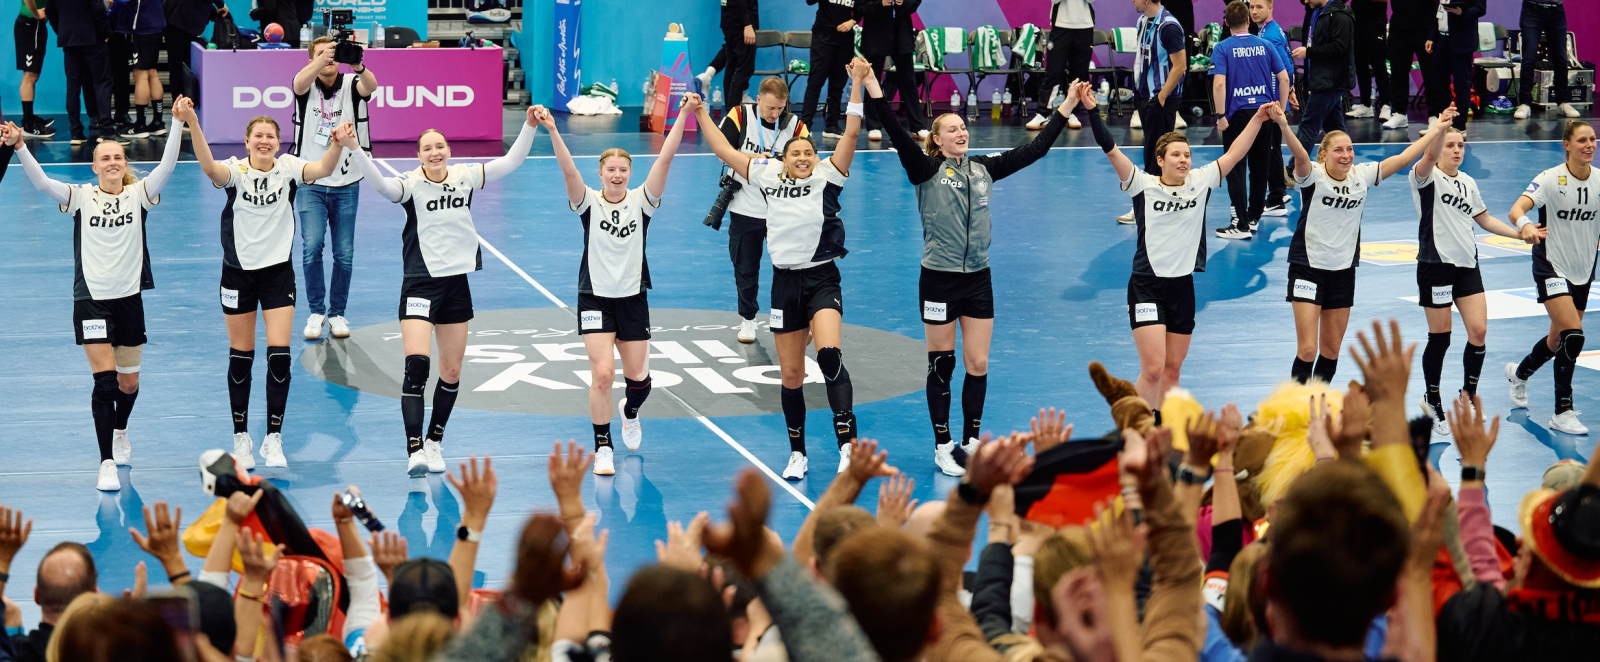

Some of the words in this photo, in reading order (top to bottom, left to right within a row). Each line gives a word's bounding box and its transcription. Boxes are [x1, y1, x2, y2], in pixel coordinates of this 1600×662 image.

[489, 8, 506, 17] hella
[253, 177, 269, 194] 14
[764, 185, 812, 199] atlas
[426, 195, 469, 212] atla
[1321, 195, 1364, 210] atlas
[1576, 186, 1589, 205] 11
[1440, 192, 1474, 216] atlas
[611, 209, 621, 225] 8
[1556, 208, 1599, 222] atlas
